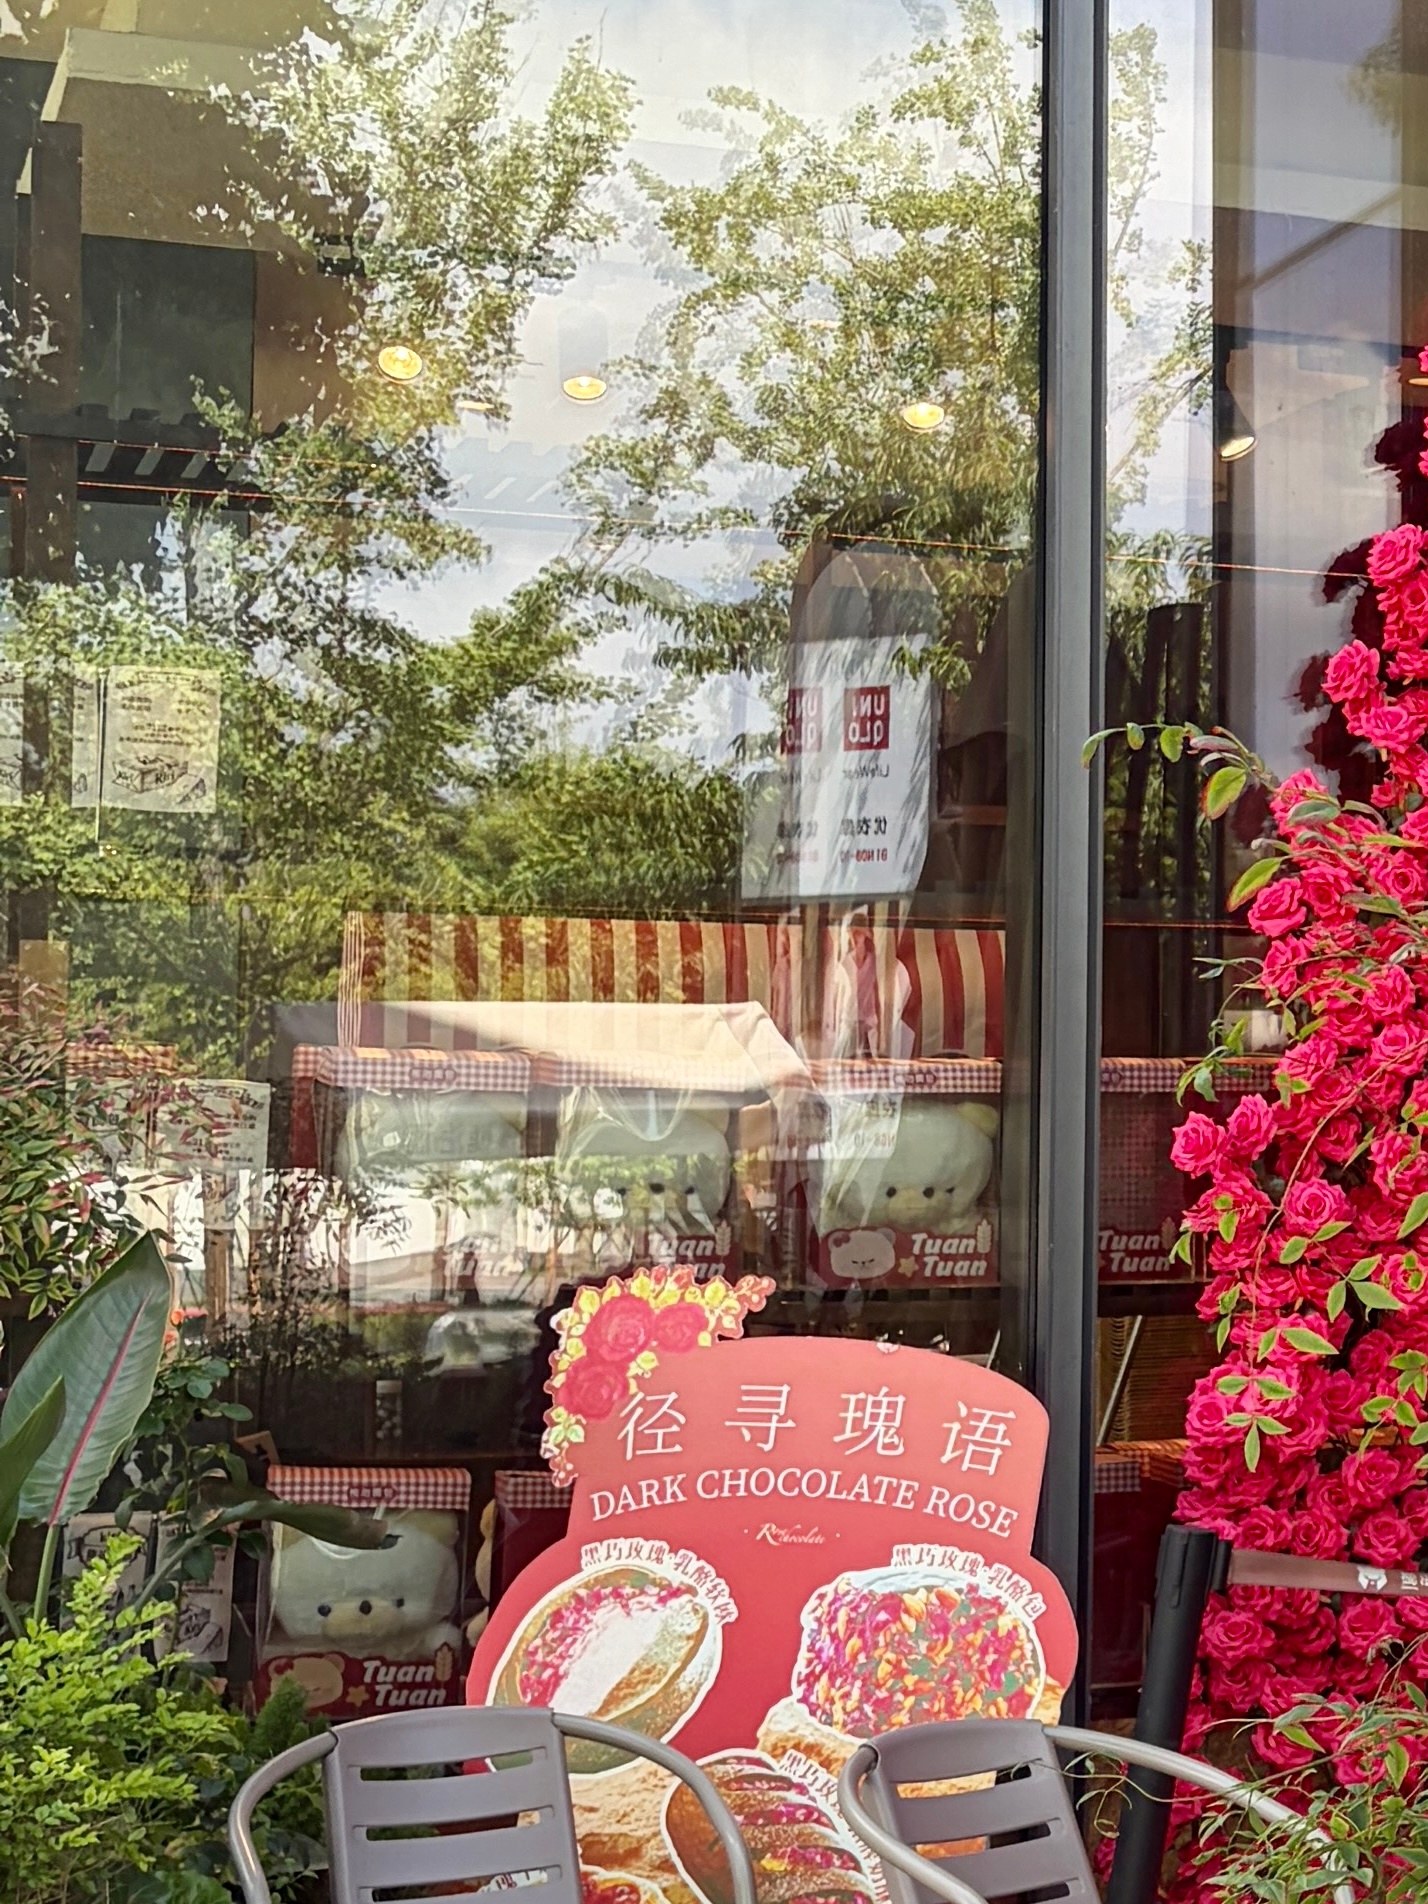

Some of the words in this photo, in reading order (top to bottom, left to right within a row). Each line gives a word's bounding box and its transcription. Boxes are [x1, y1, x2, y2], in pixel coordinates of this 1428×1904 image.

[911, 1232, 977, 1255] Tuan
[1100, 1229, 1161, 1252] Tuan
[923, 1254, 987, 1278] Tuan
[1109, 1251, 1172, 1274] Tuan
[617, 1384, 1017, 1476] 径寻瑰语
[590, 1473, 688, 1522] DARK
[696, 1466, 919, 1511] CHOCOLATE
[923, 1484, 1019, 1540] ROSE
[363, 1659, 435, 1684] Tuan
[374, 1684, 448, 1707] Tuan
